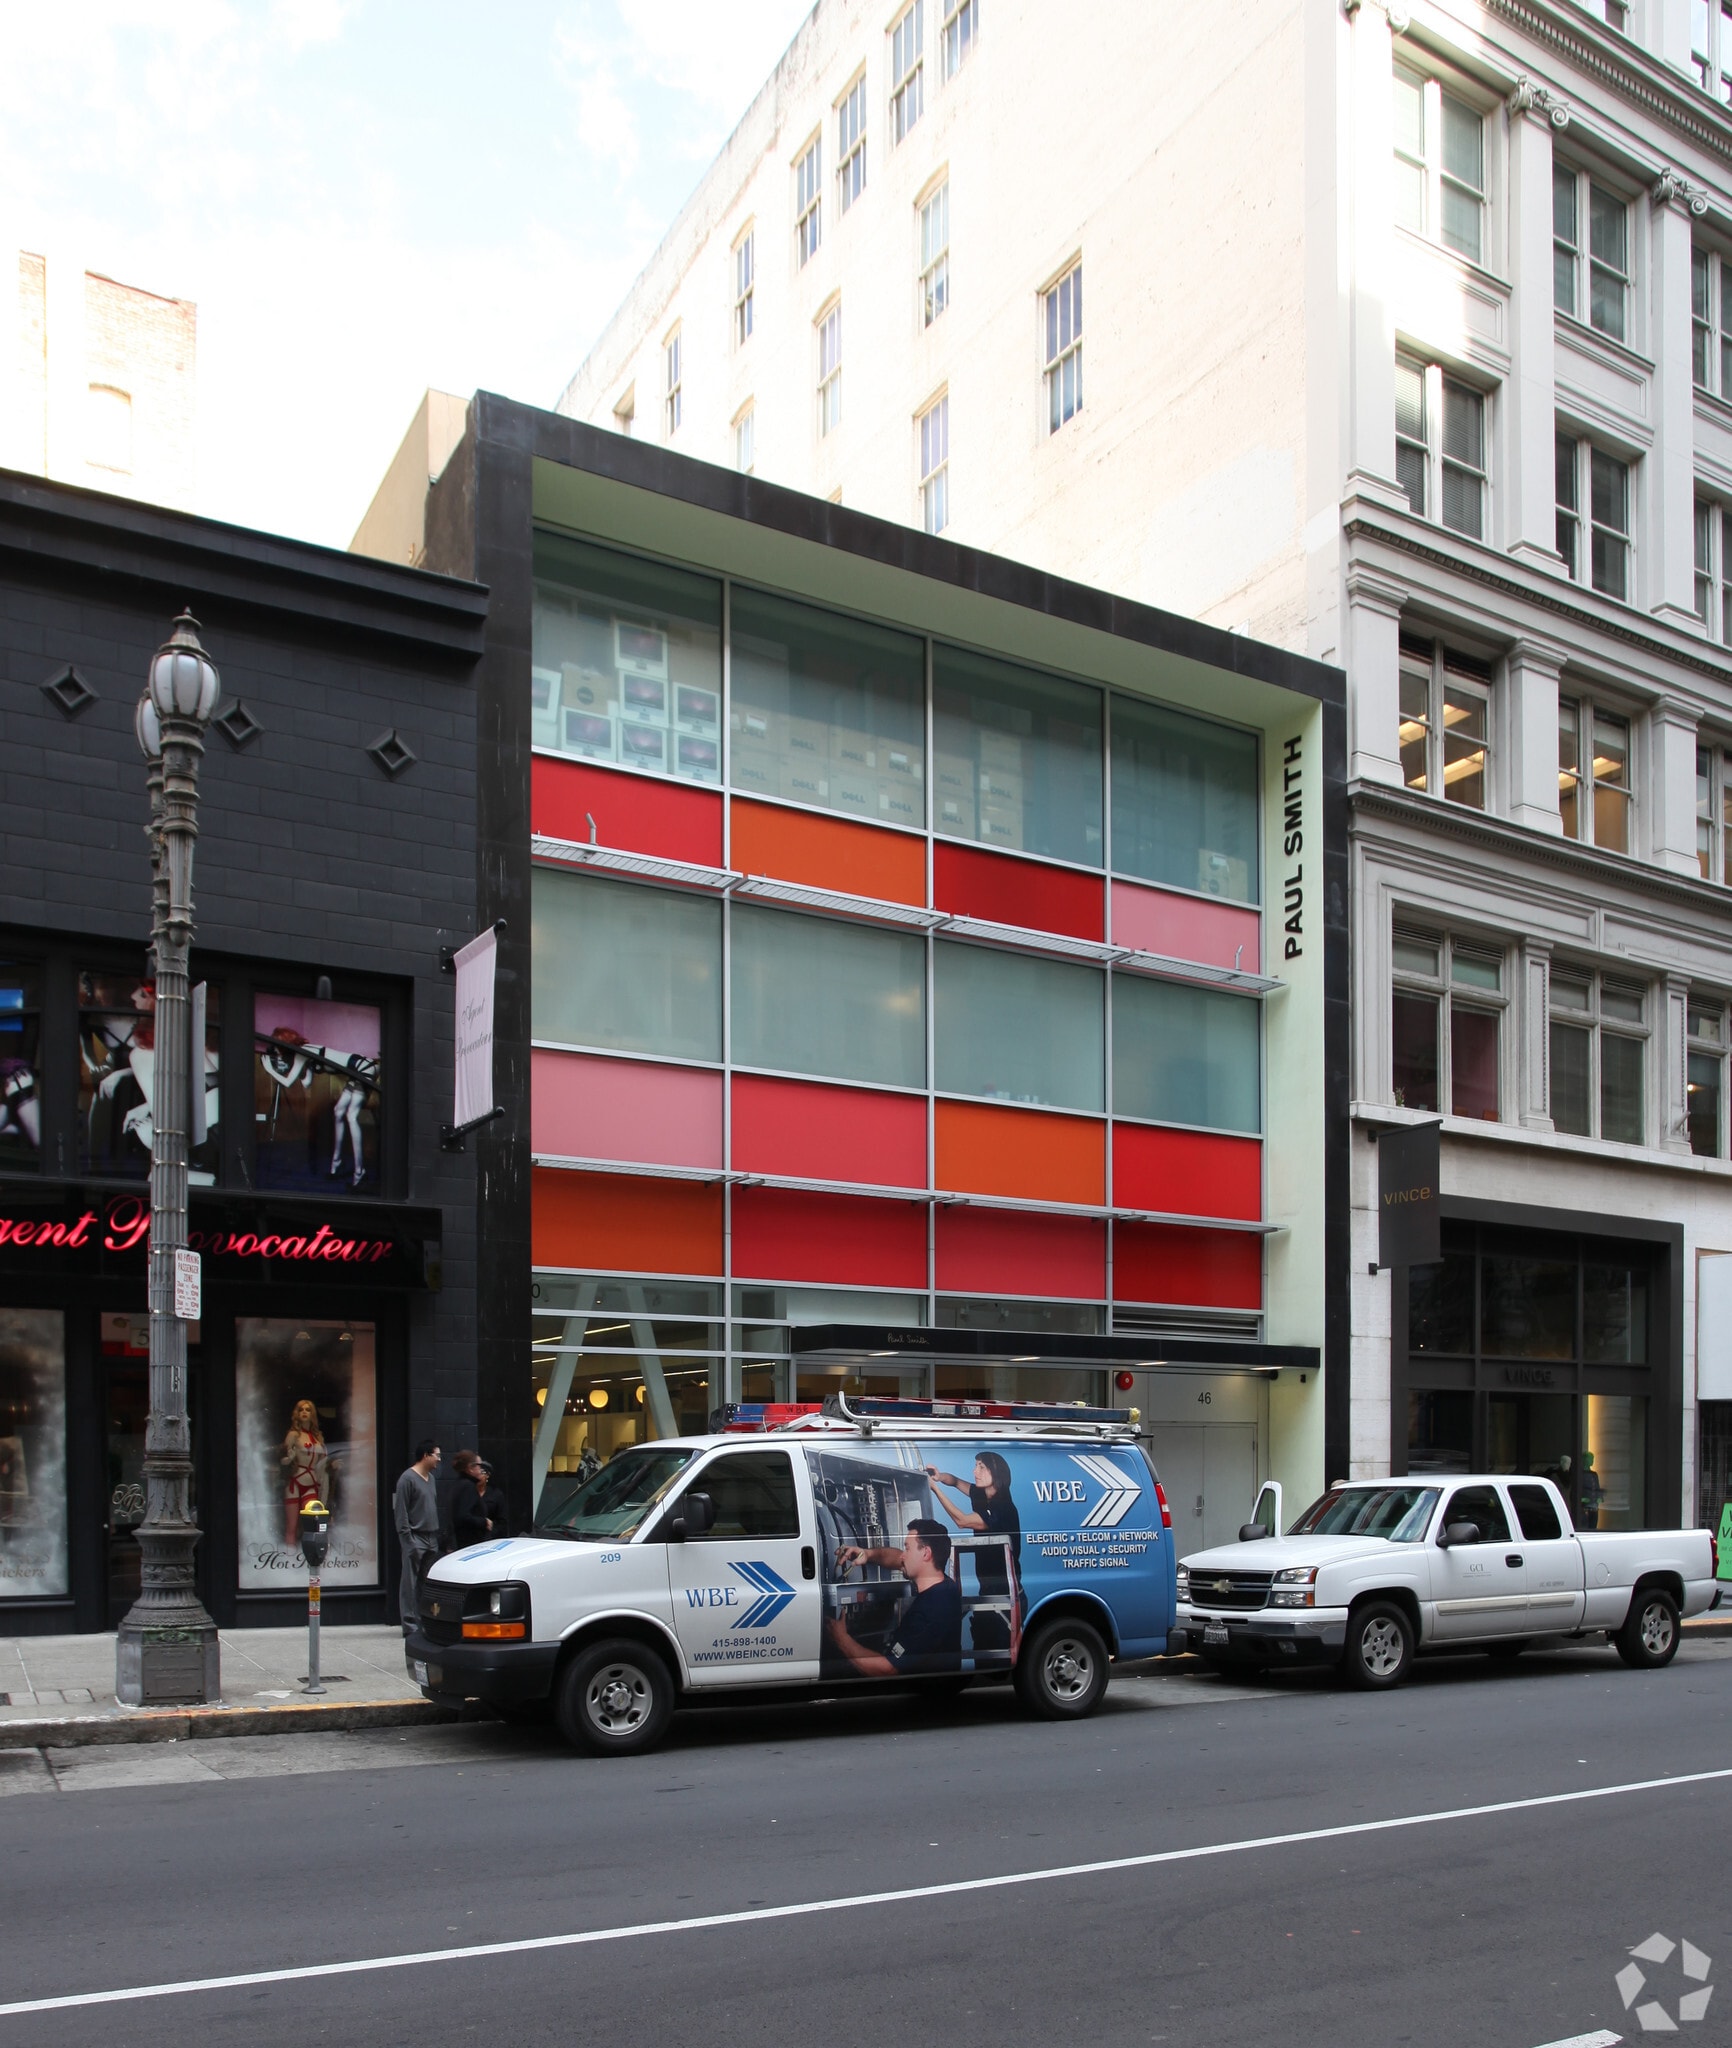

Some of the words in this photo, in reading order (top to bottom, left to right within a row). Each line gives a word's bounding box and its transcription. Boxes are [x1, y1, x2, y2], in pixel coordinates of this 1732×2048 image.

[1284, 735, 1303, 857] SMITH
[1285, 864, 1303, 960] PAUL
[104, 1194, 393, 1262] Povocateur
[1197, 1391, 1212, 1405] 46
[785, 1405, 808, 1414] WBE
[1032, 1480, 1087, 1502] WBE
[1026, 1533, 1068, 1544] ELECTRIC
[1077, 1532, 1111, 1542] TELCOM
[1119, 1531, 1158, 1541] NETWORK
[1041, 1546, 1068, 1556] AUDIO
[1070, 1545, 1100, 1556] VISUAL
[1108, 1544, 1147, 1554] SECURITY
[253, 1550, 289, 1570] Hot
[600, 1552, 622, 1564] 209
[1063, 1559, 1098, 1569] TRAFFIC
[1099, 1557, 1130, 1567] SIGNAL
[1469, 1563, 1484, 1573] GCI
[685, 1587, 739, 1608] WBE
[712, 1636, 777, 1648] 415-898-1400
[694, 1647, 794, 1661] WWW.WBEINC.COM
